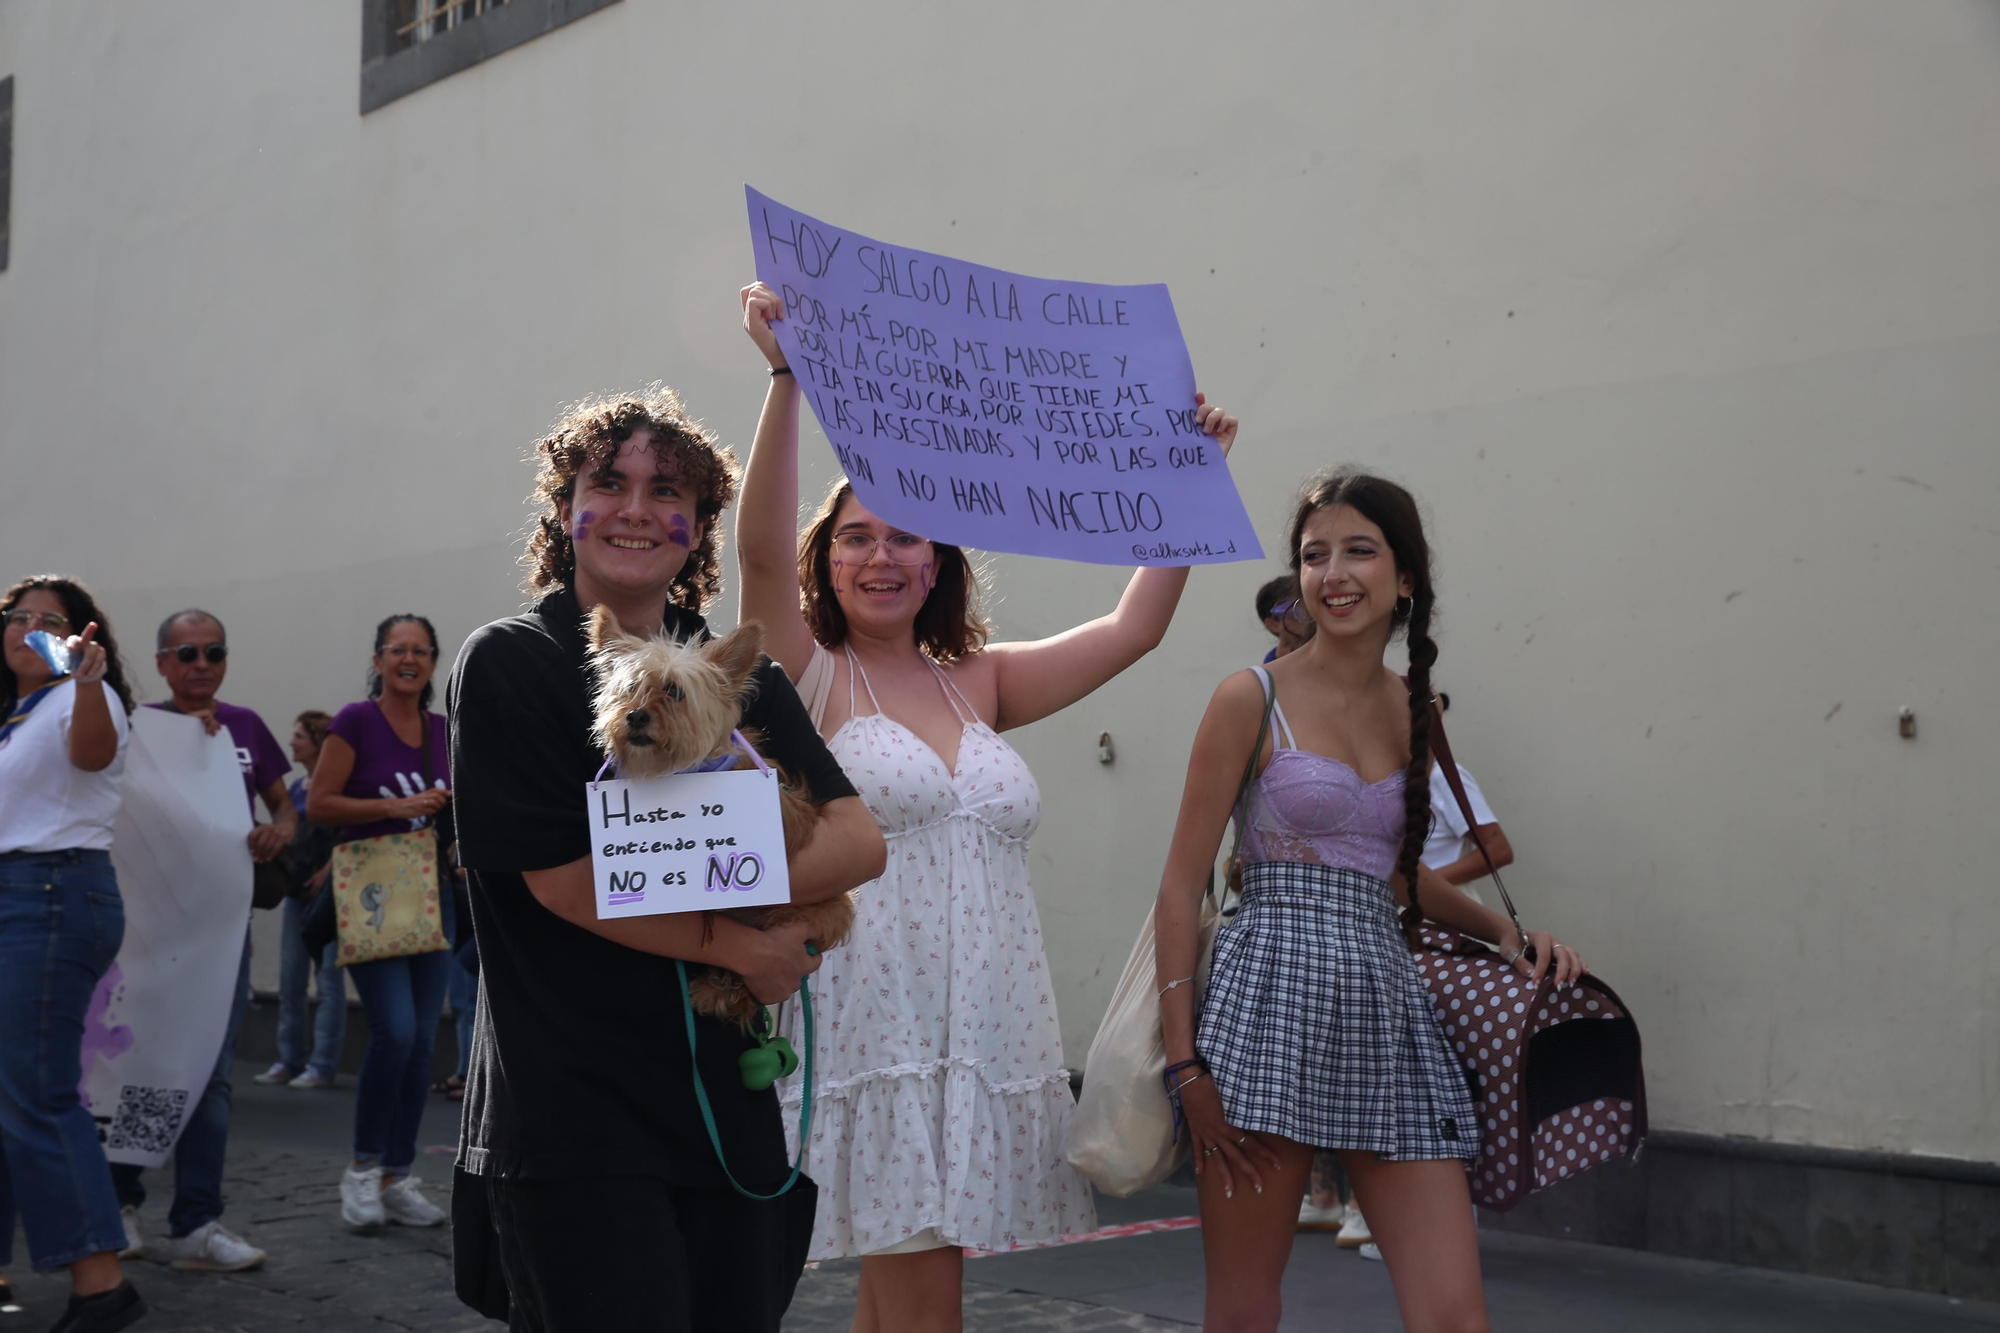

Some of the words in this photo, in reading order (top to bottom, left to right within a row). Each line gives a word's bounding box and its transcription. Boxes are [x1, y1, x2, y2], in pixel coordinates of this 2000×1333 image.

[763, 207, 841, 278] HOY
[857, 245, 950, 306] SALGO
[967, 274, 986, 318] A
[992, 281, 1022, 321] LA
[1042, 293, 1130, 325] CALLE
[782, 284, 833, 332] POR
[889, 320, 939, 358] POR
[953, 337, 996, 371] MI
[1005, 346, 1098, 379] MADRE
[1114, 355, 1127, 378] Y
[793, 325, 837, 363] POR
[839, 337, 869, 371] LA
[875, 350, 971, 392] GUERRA
[980, 377, 1025, 403] QUE
[1029, 384, 1104, 409] TIENE
[1113, 383, 1154, 407] MI
[800, 354, 845, 393] TÍA
[853, 375, 884, 403] EN
[890, 382, 921, 410] SU
[980, 399, 1024, 426] POR
[815, 390, 863, 434] LAS
[873, 408, 1014, 458] ASESINADAS
[1022, 434, 1041, 461] Y
[1054, 439, 1102, 467] POR
[1110, 446, 1157, 472] LAS
[1169, 446, 1208, 469] QUE
[896, 467, 936, 502] NO
[950, 476, 1006, 516] HAN
[1026, 485, 1164, 535] NACIDO
[601, 788, 686, 829] Hasta
[602, 837, 696, 858] entiendo
[705, 836, 737, 850] que
[609, 870, 647, 893] NO
[662, 870, 687, 886] es
[705, 853, 763, 890] NO
